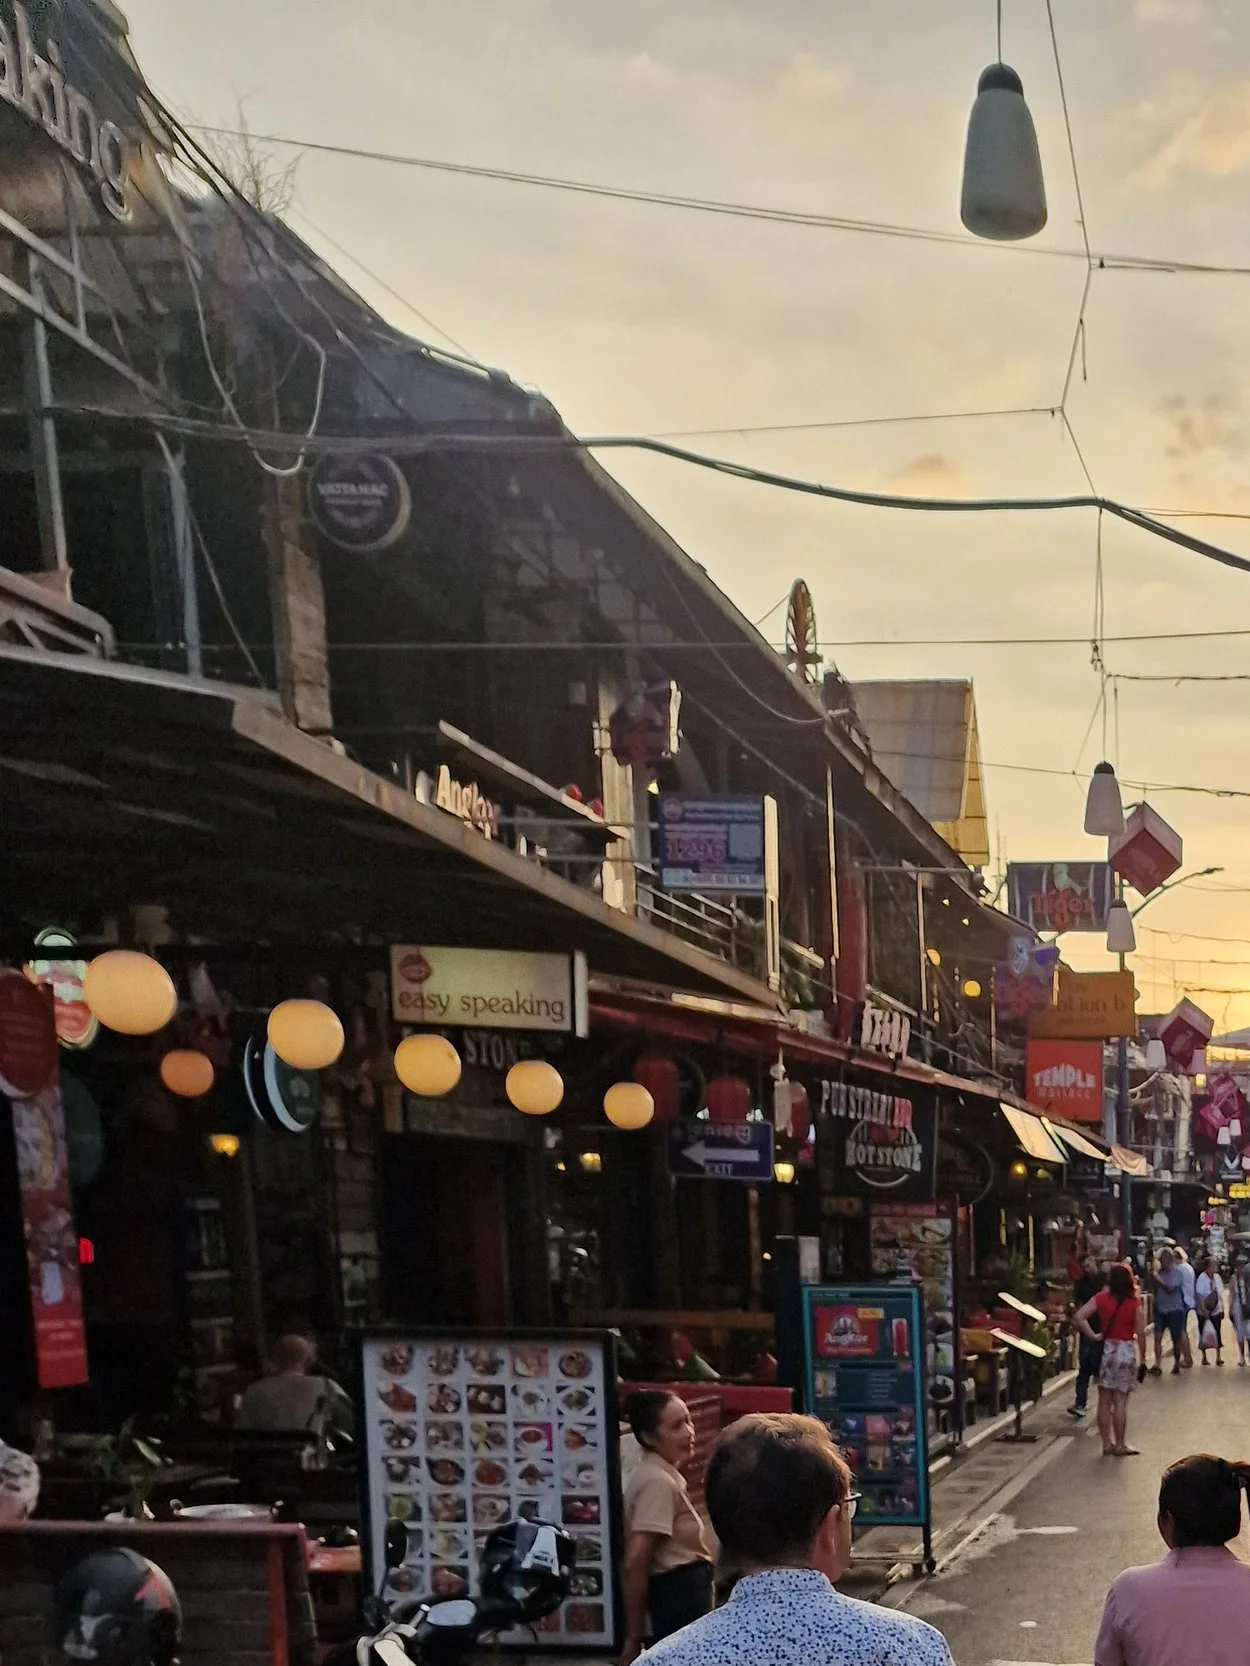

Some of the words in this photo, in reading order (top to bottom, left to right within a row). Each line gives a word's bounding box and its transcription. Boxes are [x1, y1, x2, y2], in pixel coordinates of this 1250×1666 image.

[399, 989, 450, 1016] easy
[461, 988, 566, 1023] speaking
[1033, 1063, 1096, 1088] TEMPLE
